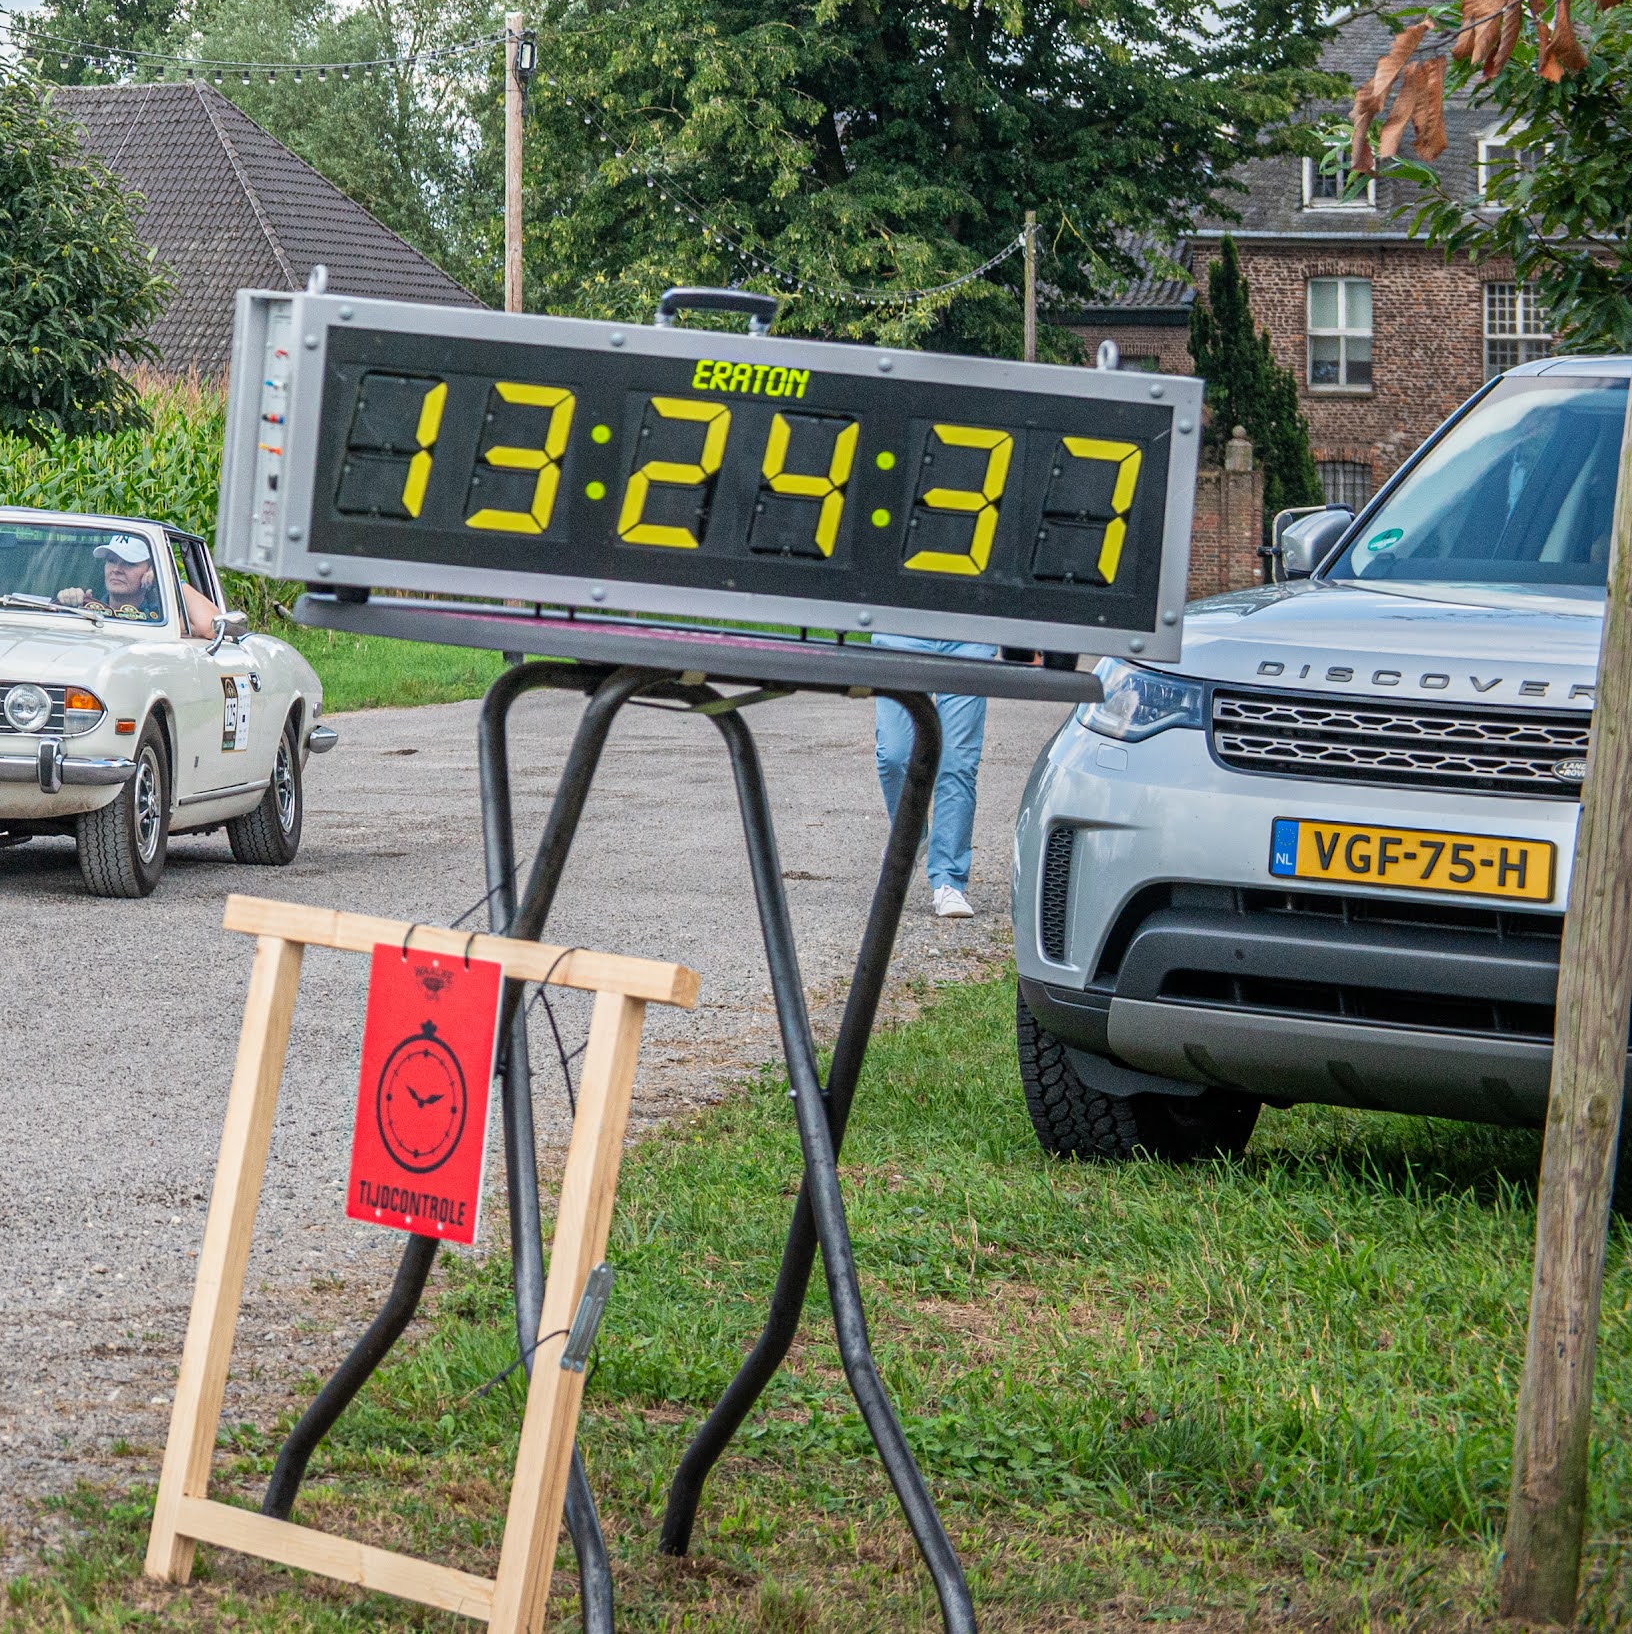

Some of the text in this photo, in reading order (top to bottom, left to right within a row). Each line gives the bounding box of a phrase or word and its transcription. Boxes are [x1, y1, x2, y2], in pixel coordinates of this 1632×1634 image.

[692, 359, 811, 399] ERATON
[402, 379, 1142, 584] 13:24:37
[1563, 769, 1585, 777] ROV
[1275, 830, 1528, 889] NL VGF-75-H
[359, 1179, 466, 1226] TIJDCONTROLE
